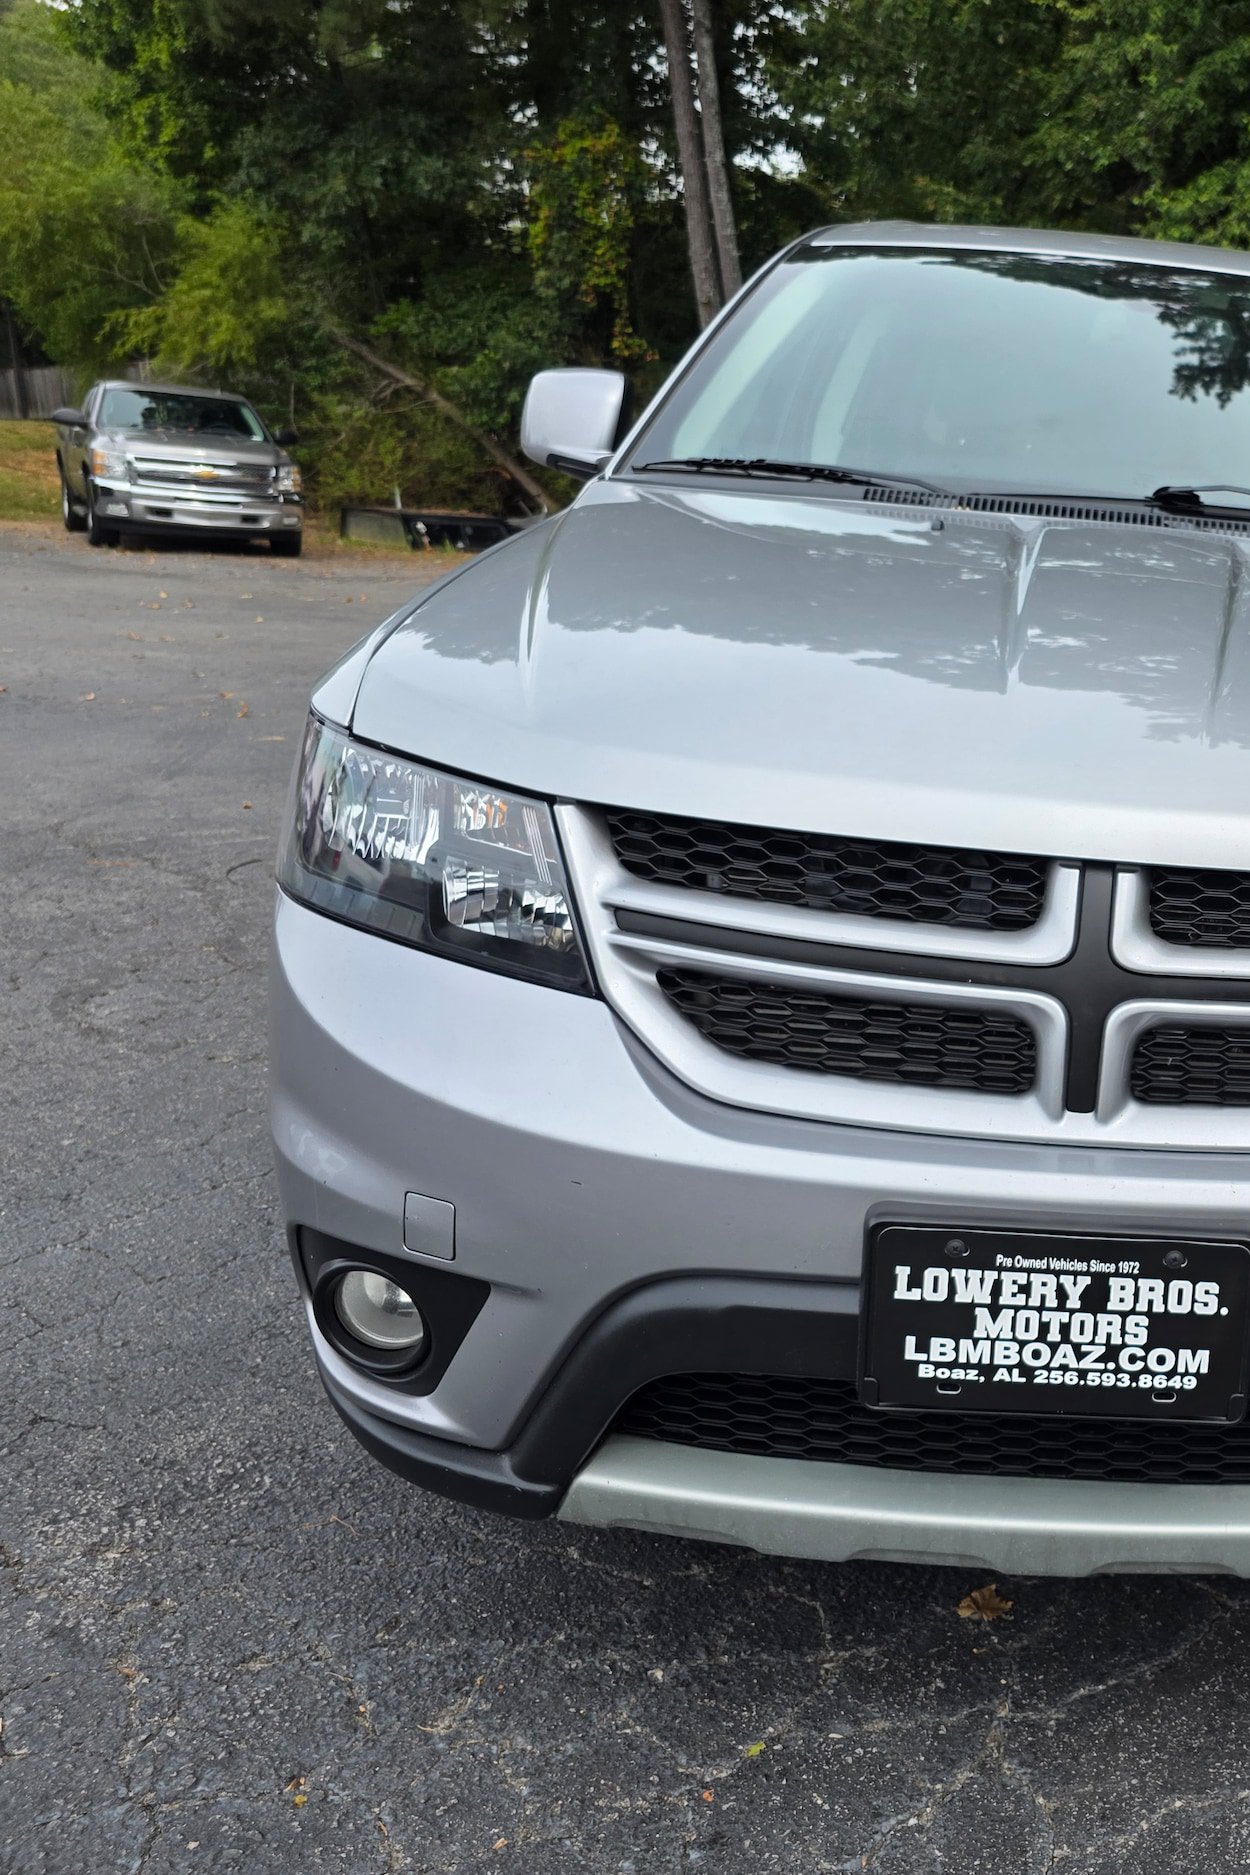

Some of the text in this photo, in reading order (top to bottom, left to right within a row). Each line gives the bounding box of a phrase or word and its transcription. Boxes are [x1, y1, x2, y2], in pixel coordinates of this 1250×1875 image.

[996, 1254, 1140, 1274] Pre Owned Vehicles Since 1972
[893, 1265, 1229, 1316] LOWERY BROS.
[973, 1307, 1149, 1346] MOTORS
[904, 1335, 1210, 1374] LBMBOAZ.COM
[918, 1363, 1197, 1390] Boaz, AL 256.593.8649
